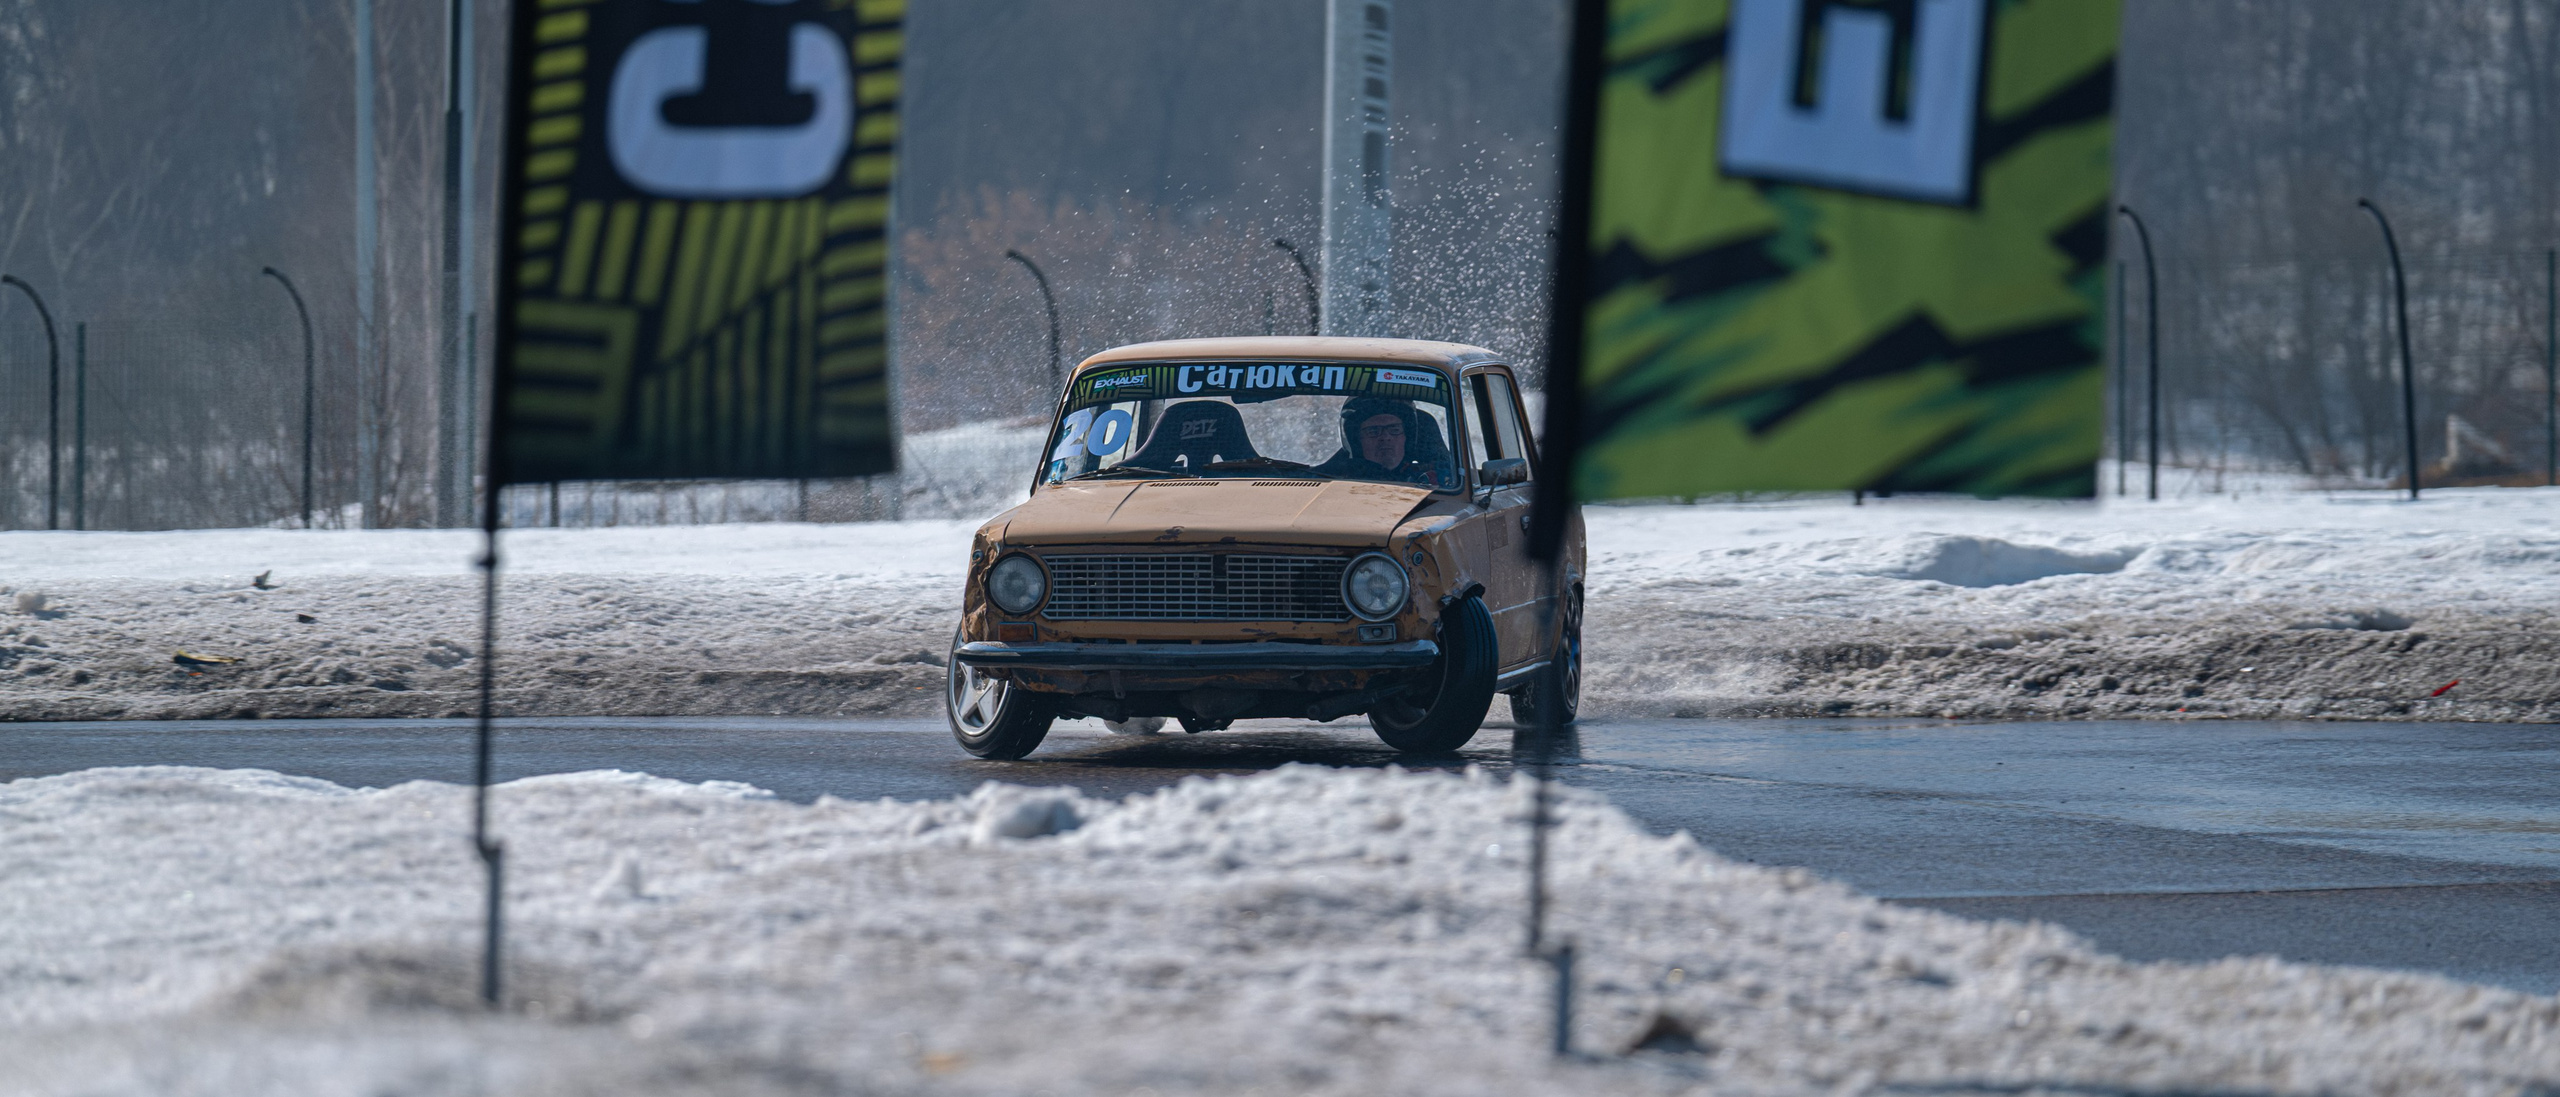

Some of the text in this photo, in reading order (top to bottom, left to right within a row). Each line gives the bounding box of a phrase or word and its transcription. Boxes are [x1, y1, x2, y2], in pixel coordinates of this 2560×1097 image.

[1094, 374, 1148, 389] EXHAUST
[1395, 374, 1430, 384] TAKAYAMA
[1051, 408, 1133, 463] 20
